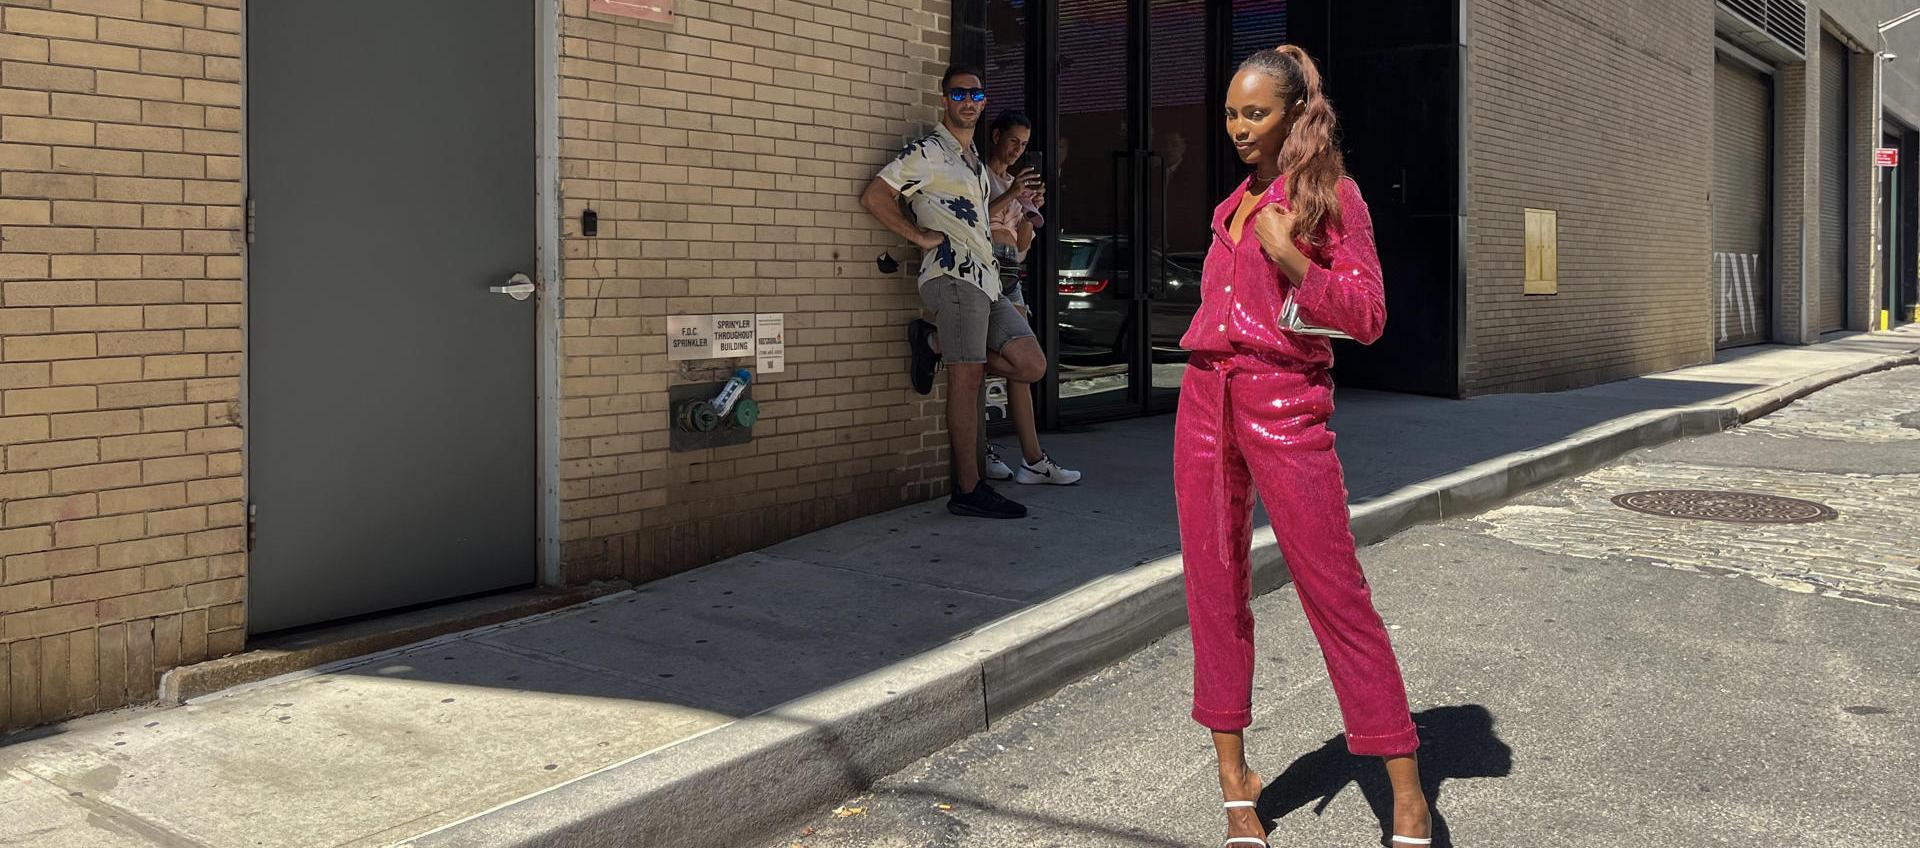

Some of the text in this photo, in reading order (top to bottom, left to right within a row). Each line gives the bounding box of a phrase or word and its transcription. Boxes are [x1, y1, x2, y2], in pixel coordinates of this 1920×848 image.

[714, 331, 753, 340] THROUGHOUT
[673, 338, 708, 348] SPRINKLER
[720, 342, 748, 351] BUILDING
